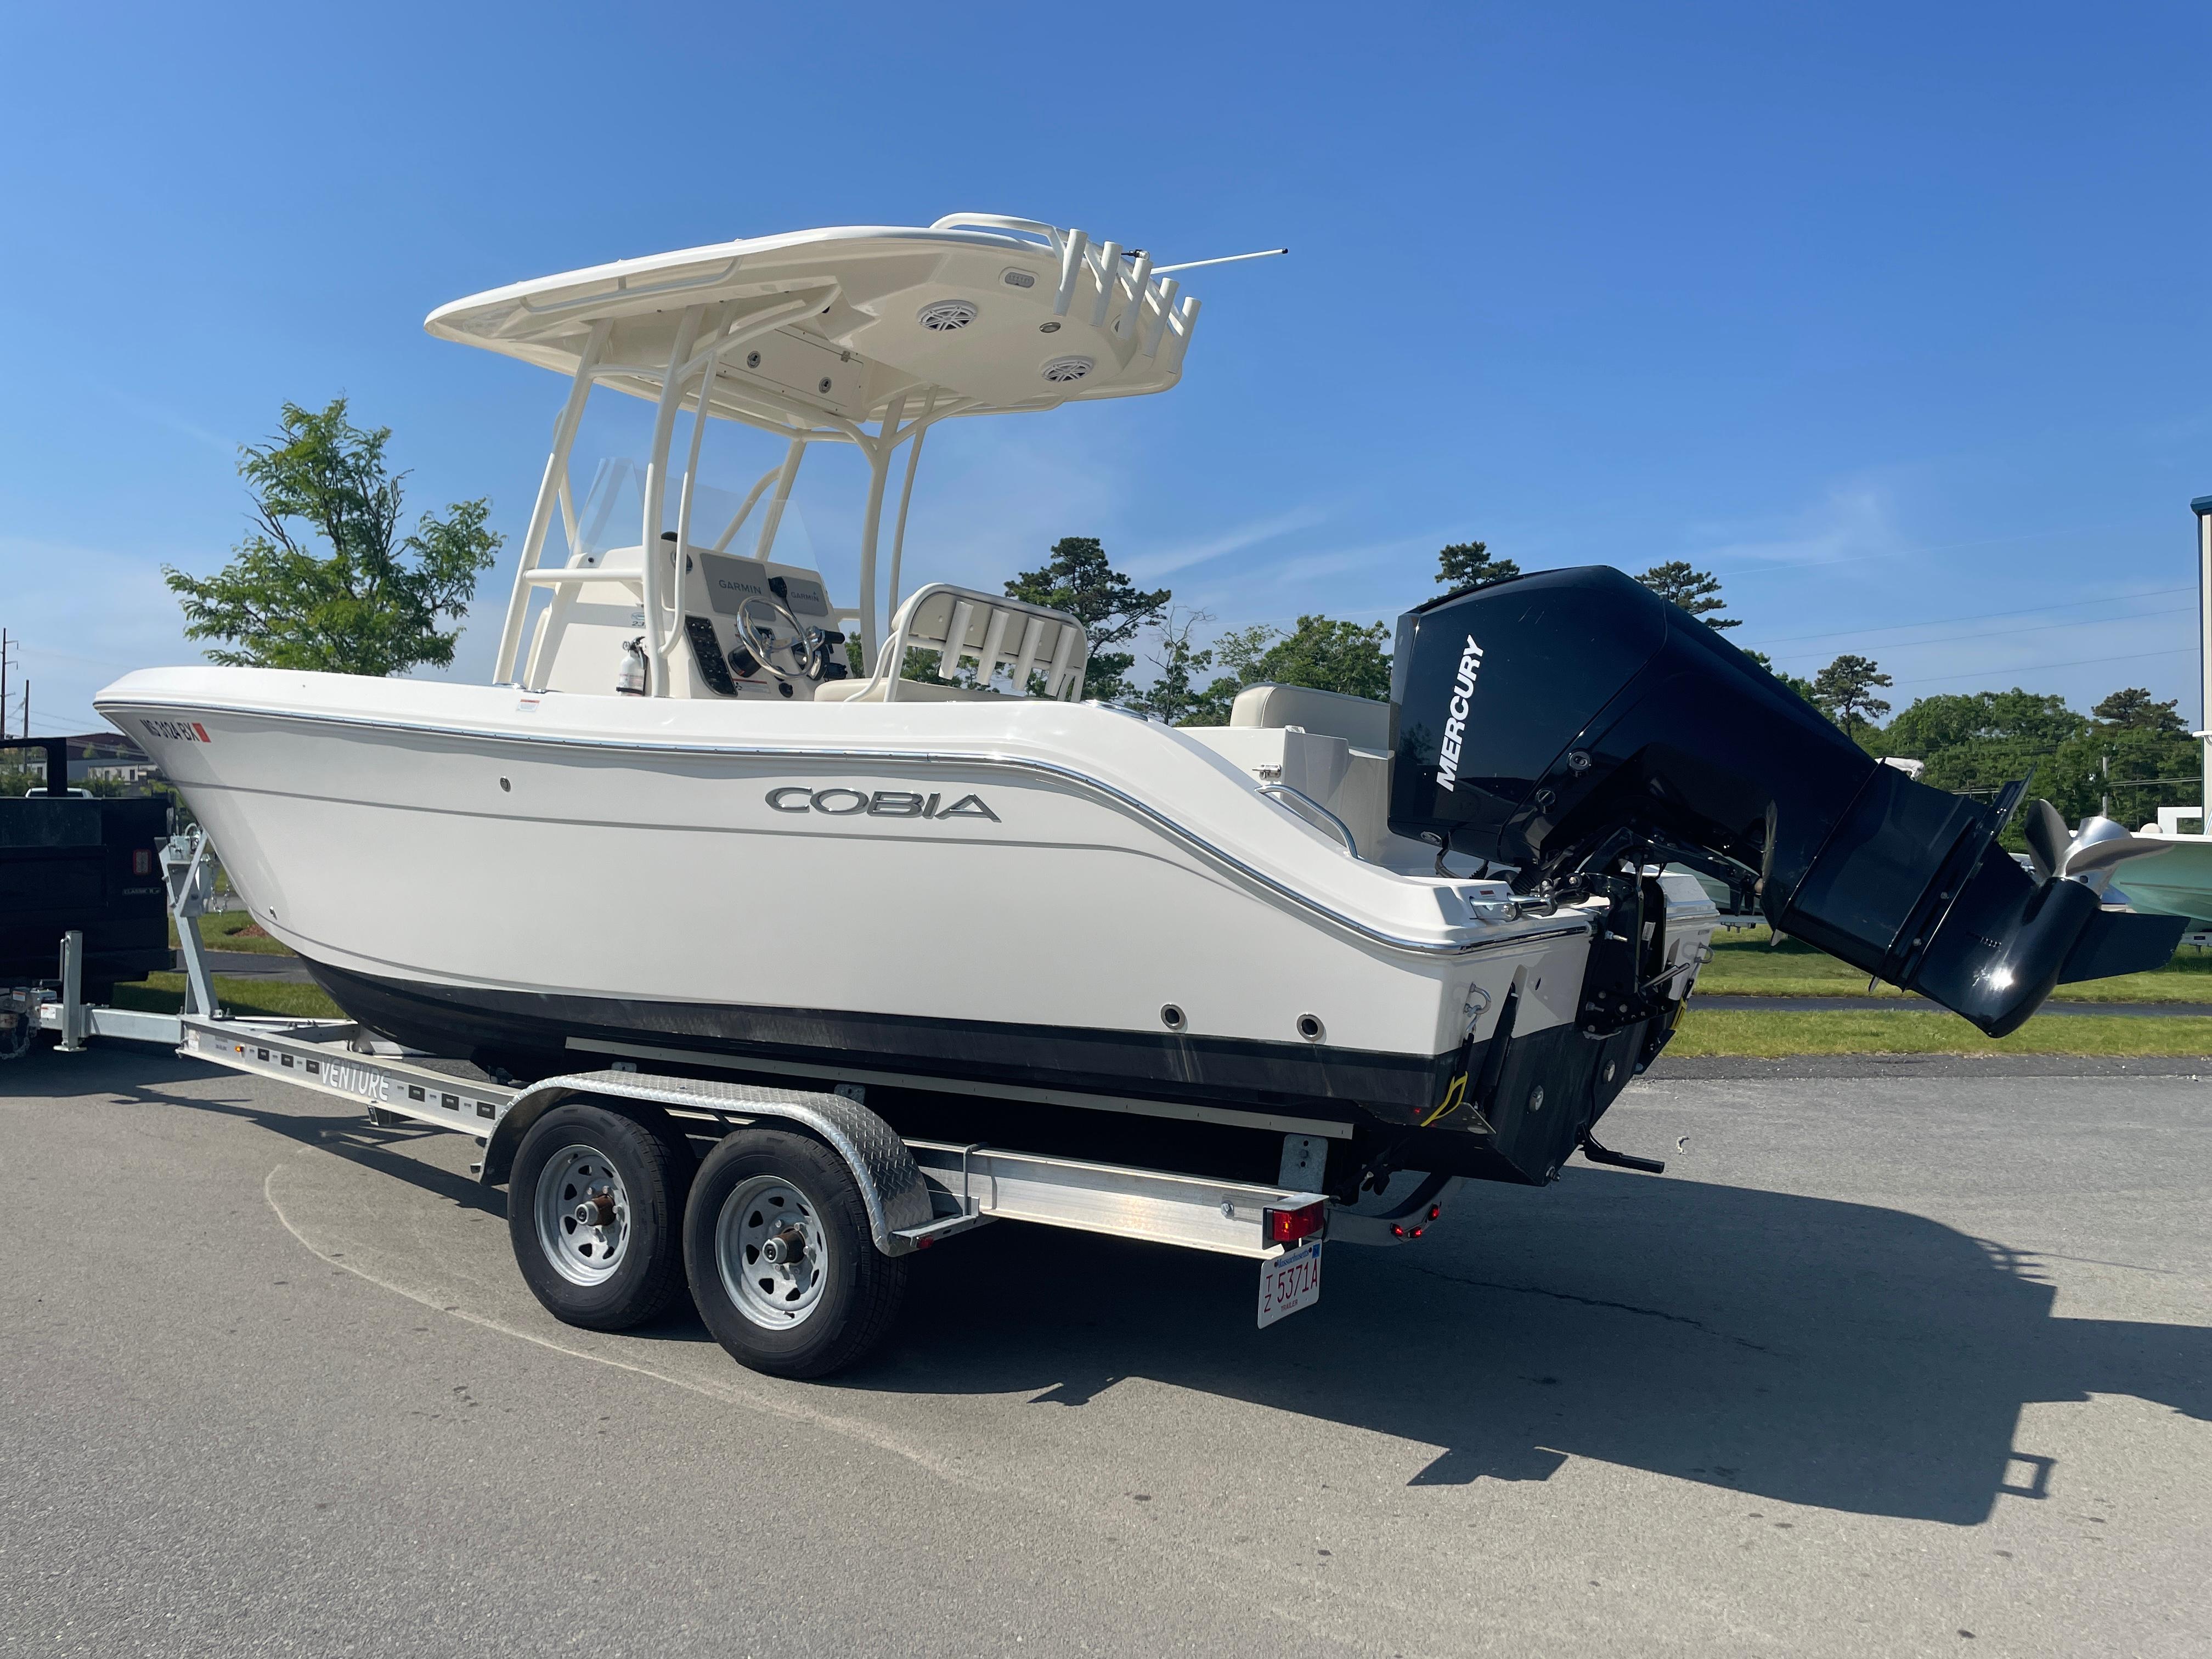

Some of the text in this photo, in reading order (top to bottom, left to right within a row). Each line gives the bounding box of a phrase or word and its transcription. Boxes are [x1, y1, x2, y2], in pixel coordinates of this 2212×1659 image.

[719, 579, 761, 594] GARMIN
[791, 591, 820, 602] GARMIN
[1436, 634, 1483, 792] MERCURY
[177, 722, 200, 742] BX
[765, 787, 1002, 823] COBIA
[320, 1054, 391, 1102] VENTURE
[1277, 1259, 1318, 1303] 5371A
[1281, 1299, 1298, 1312] TRAILER
